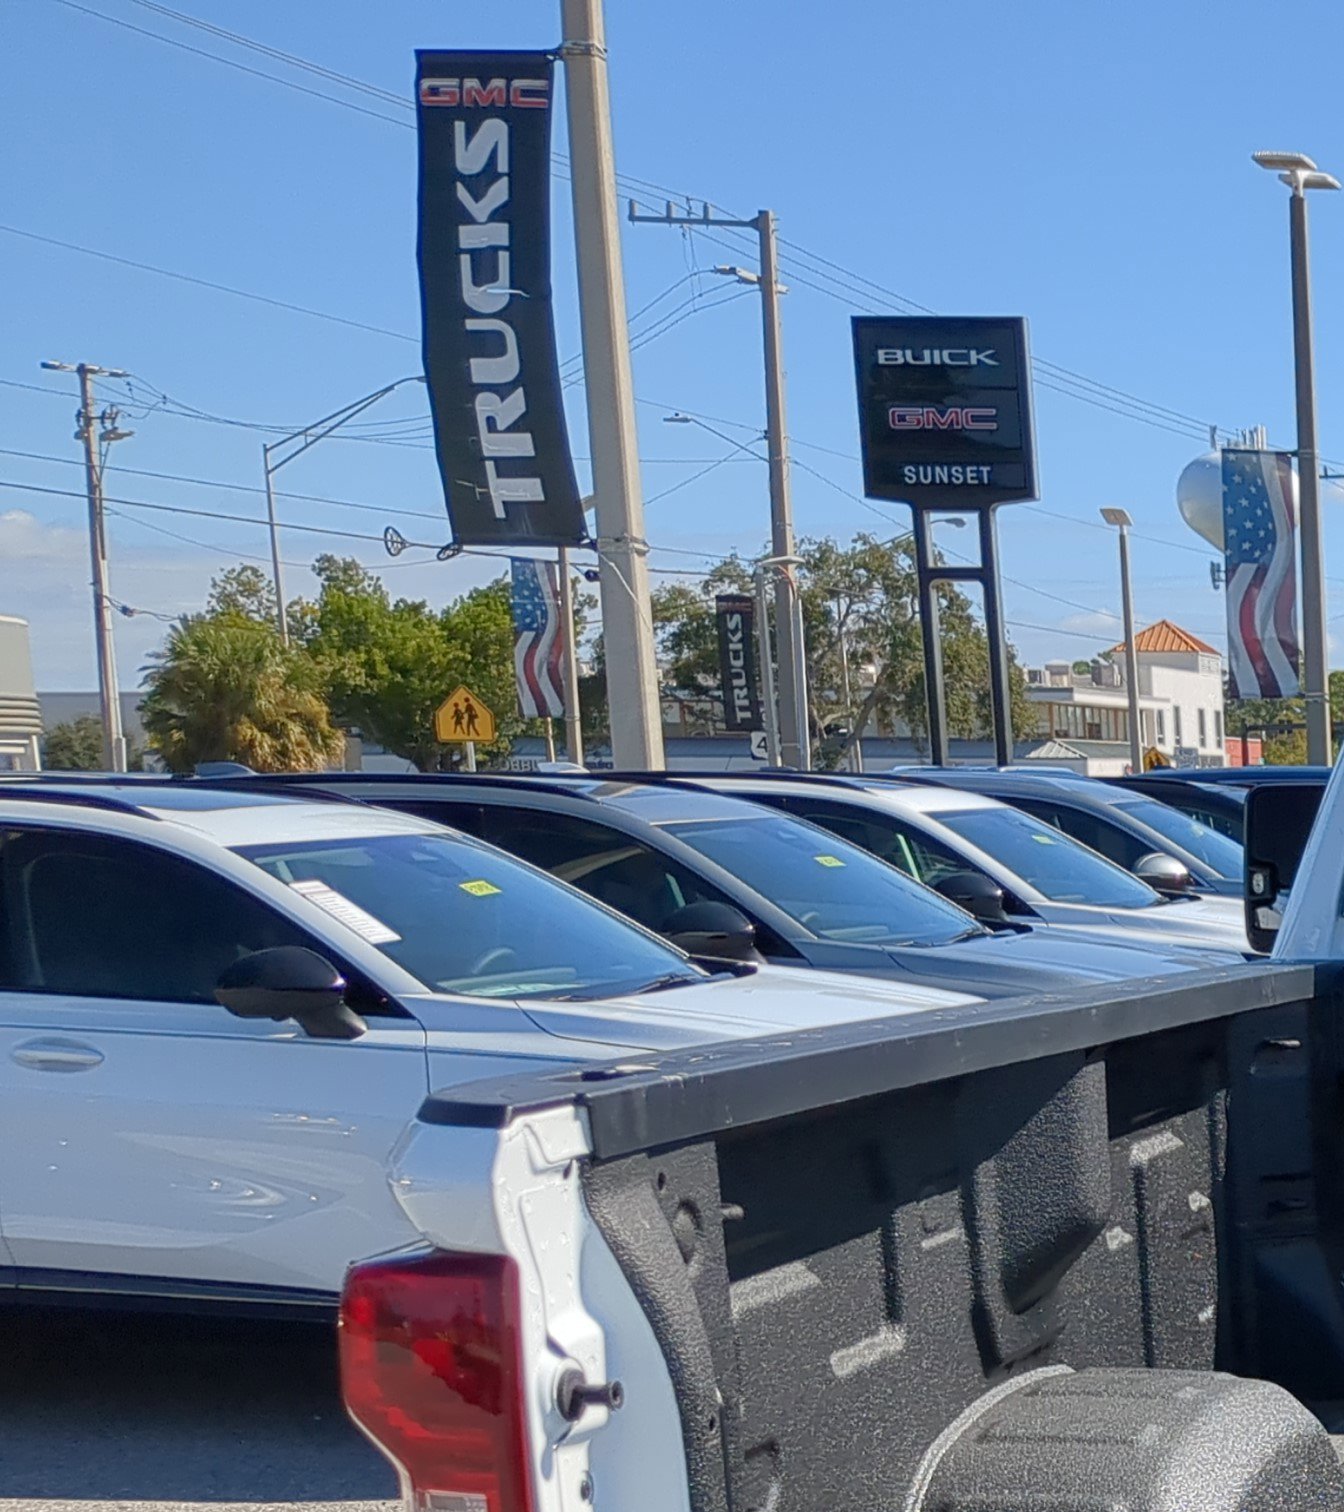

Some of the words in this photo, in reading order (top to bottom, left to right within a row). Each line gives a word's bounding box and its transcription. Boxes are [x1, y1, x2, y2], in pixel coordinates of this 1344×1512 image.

[420, 78, 549, 108] GMC
[454, 117, 546, 518] TRUCKS
[877, 349, 1000, 366] BUICK
[889, 408, 997, 430] GMC
[904, 465, 991, 484] SUNSET
[726, 613, 752, 724] TRUCKS
